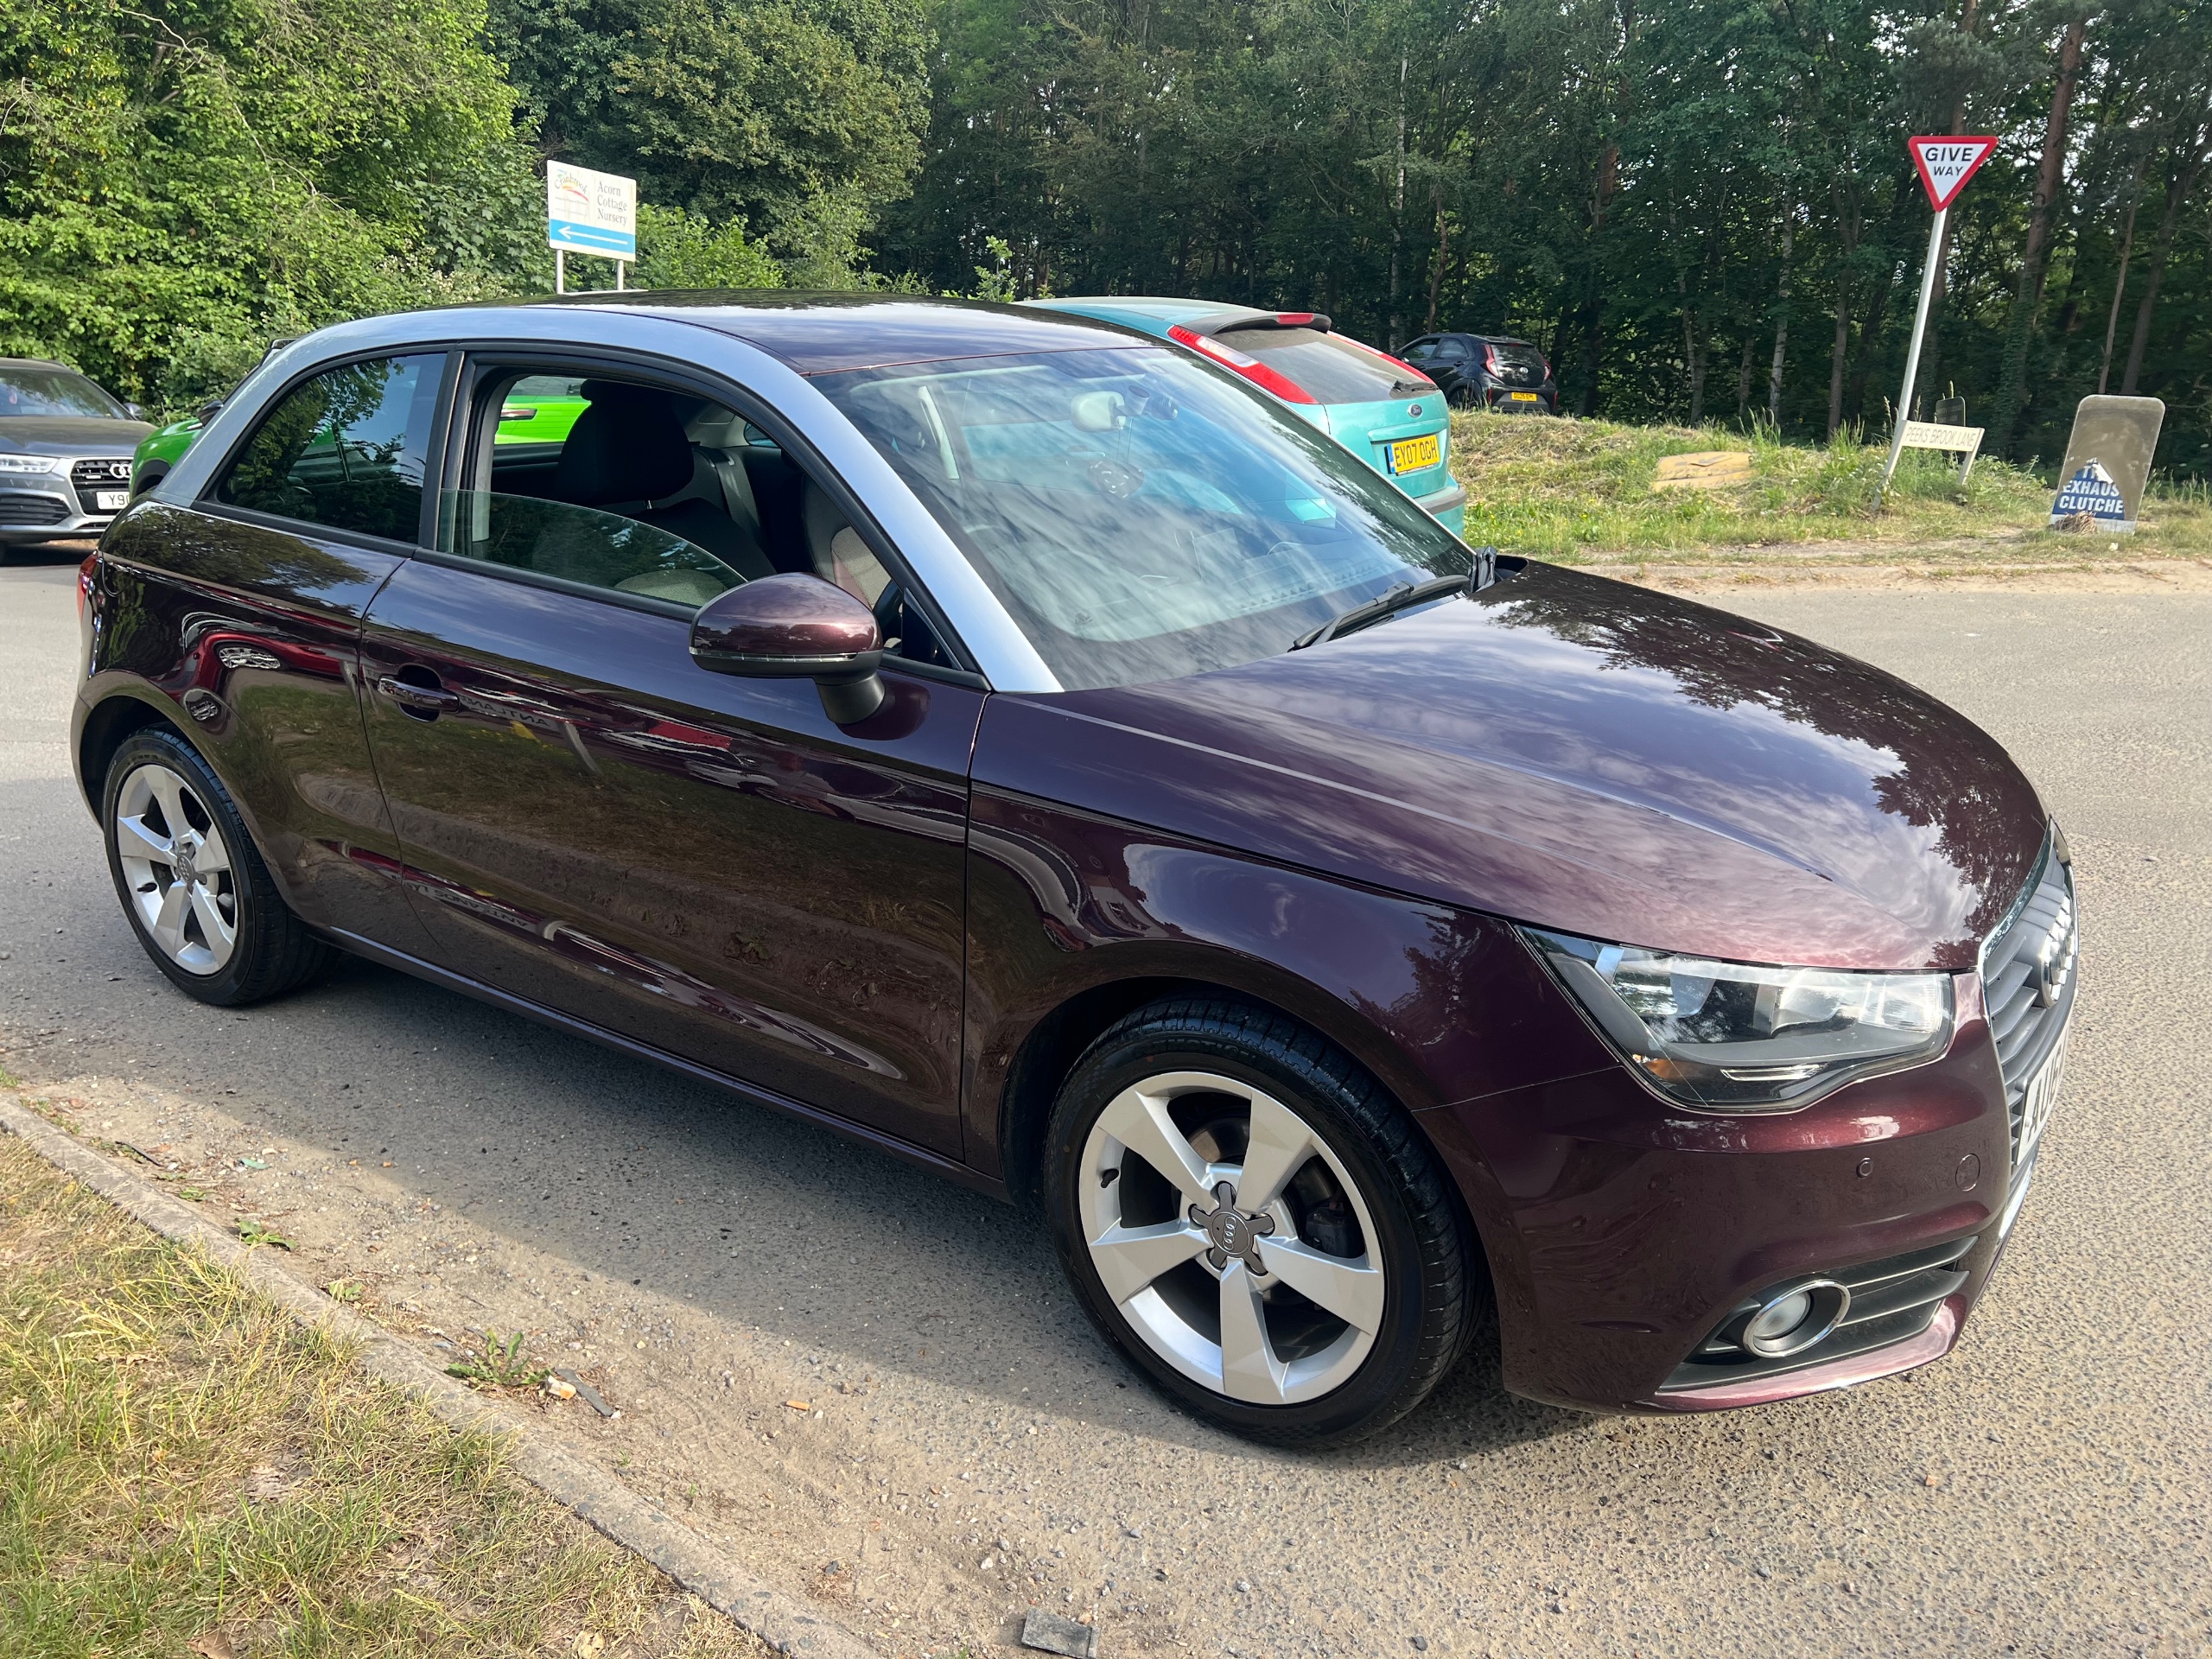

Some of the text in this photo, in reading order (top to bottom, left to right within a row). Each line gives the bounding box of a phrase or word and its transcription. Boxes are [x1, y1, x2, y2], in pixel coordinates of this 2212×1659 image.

[1925, 147, 1974, 162] GIVE
[1933, 166, 1963, 176] WAY
[554, 174, 588, 194] Cranbrook
[597, 181, 620, 196] Acorn
[597, 194, 627, 213] Cottage
[597, 207, 627, 226] Nursery
[1904, 427, 1976, 447] PEEKS BROOK LANE
[1394, 438, 1438, 467] EY07 OGH
[2059, 495, 2124, 513] CLUTCHE
